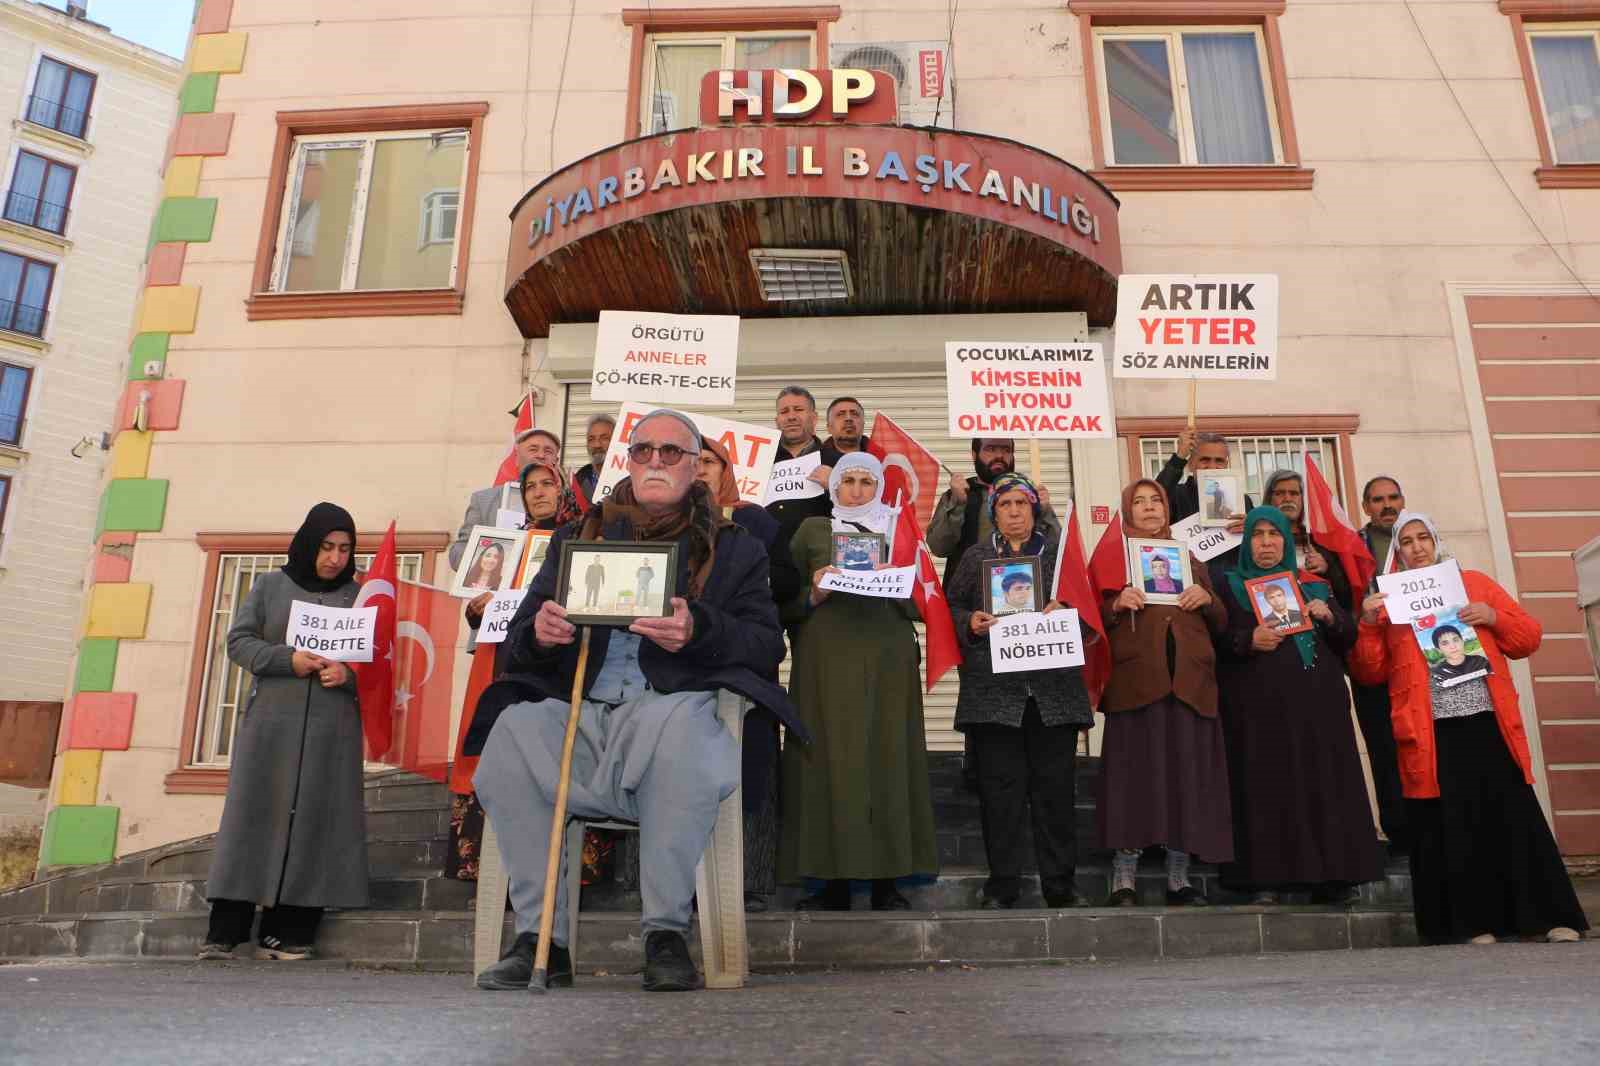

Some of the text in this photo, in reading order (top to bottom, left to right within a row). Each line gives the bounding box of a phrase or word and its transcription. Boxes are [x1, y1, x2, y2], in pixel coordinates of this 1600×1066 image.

[924, 51, 938, 97] VESTEL
[718, 68, 876, 118] HDP
[527, 147, 765, 248] DİYARBAKIR
[843, 147, 1099, 244] BAŞKANLIĞI
[1140, 283, 1256, 311] ARTIK
[631, 324, 704, 342] ÖRGÜTÜ
[1138, 317, 1256, 345] YETER
[624, 350, 707, 366] ANNELER
[956, 346, 1094, 363] ÇOCUKLARIMIZ
[1121, 353, 1270, 370] SÖZ ANNELERİN
[595, 369, 732, 389] ÇÖ-KER-TE-CEK
[970, 367, 1082, 387] KİMSENİN
[984, 389, 1072, 409] PİYONU
[957, 414, 1103, 432] OLMAYACAK
[775, 480, 805, 493] GÜN
[1199, 532, 1225, 551] GÜN
[868, 574, 905, 584] AİLE
[1400, 577, 1441, 595] 2012.
[1410, 596, 1444, 612] GÜN
[301, 614, 365, 631] 381 AİLE
[1001, 618, 1069, 639] 381 AİLE
[294, 633, 366, 651] NÖBETTE
[999, 640, 1075, 661] NÖBETTE
